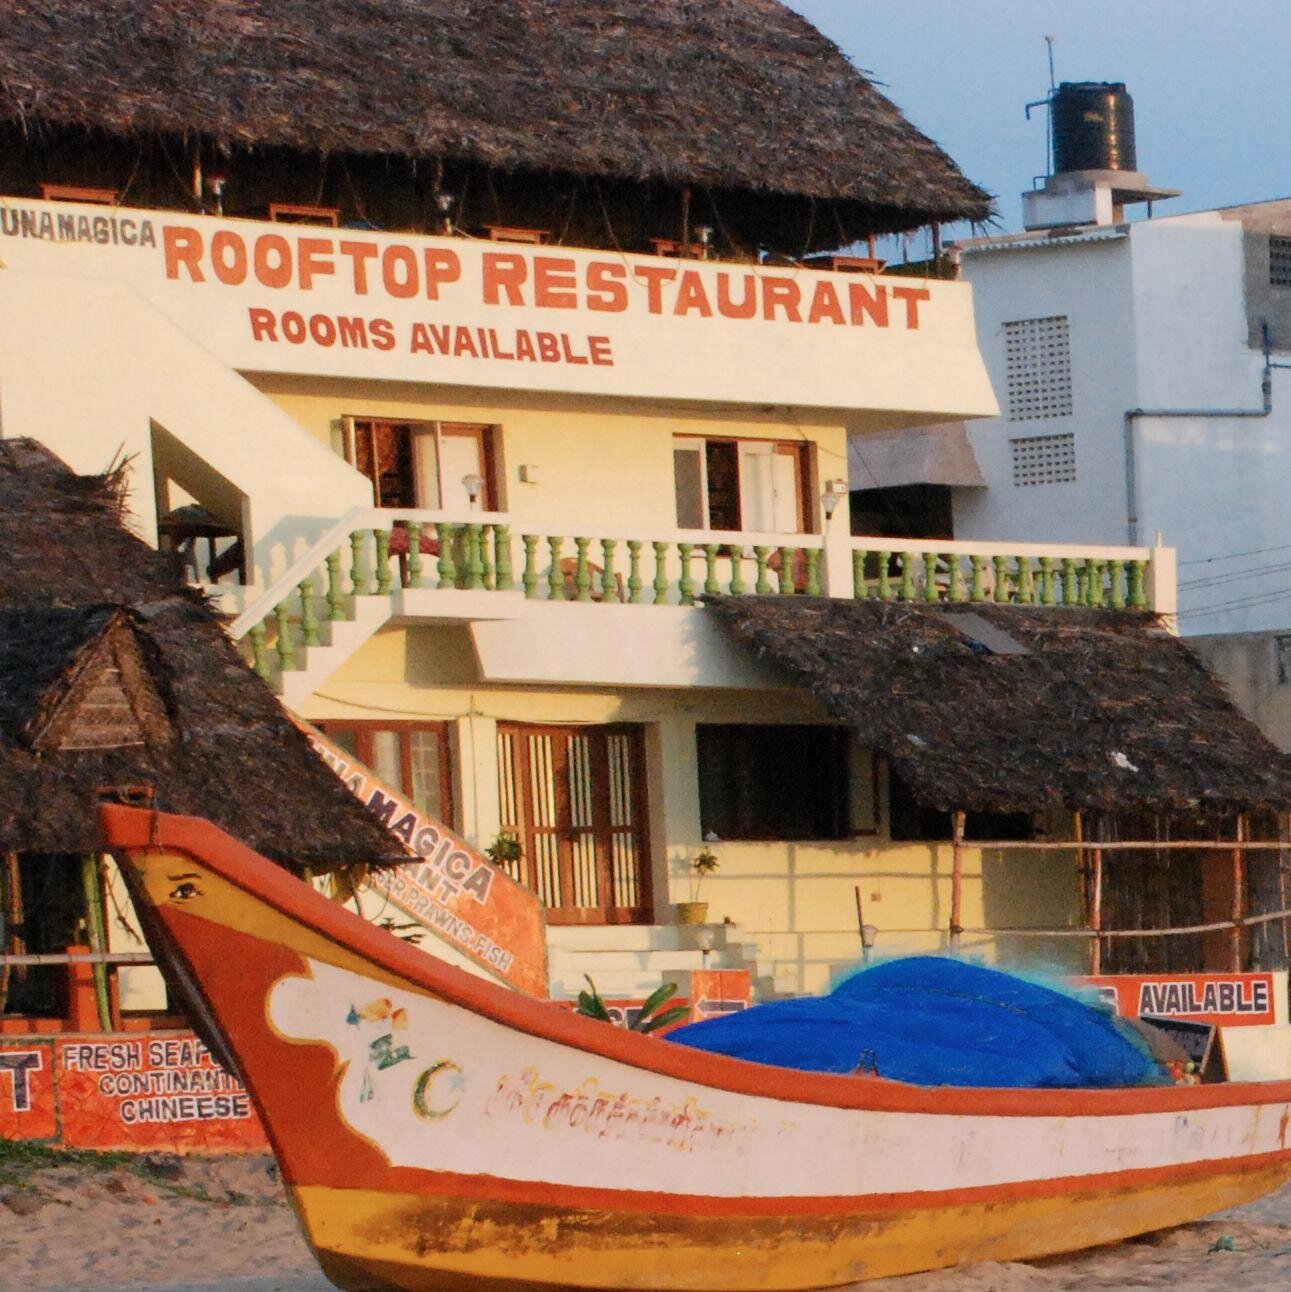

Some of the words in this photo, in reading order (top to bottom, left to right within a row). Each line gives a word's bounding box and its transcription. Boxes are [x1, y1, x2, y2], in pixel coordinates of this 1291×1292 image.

[162, 225, 462, 301] ROOFTOP
[482, 251, 931, 330] RESTAURANT
[248, 307, 396, 351] ROOMS
[410, 322, 614, 366] AVAILABLE
[366, 788, 494, 904] MAGICA
[1139, 981, 1270, 1016] AVAILABLE
[62, 1042, 141, 1071] FRESH
[150, 1038, 221, 1068] SEAF
[99, 1067, 246, 1096] CONTINANT
[120, 1093, 252, 1124] CHINEESE
